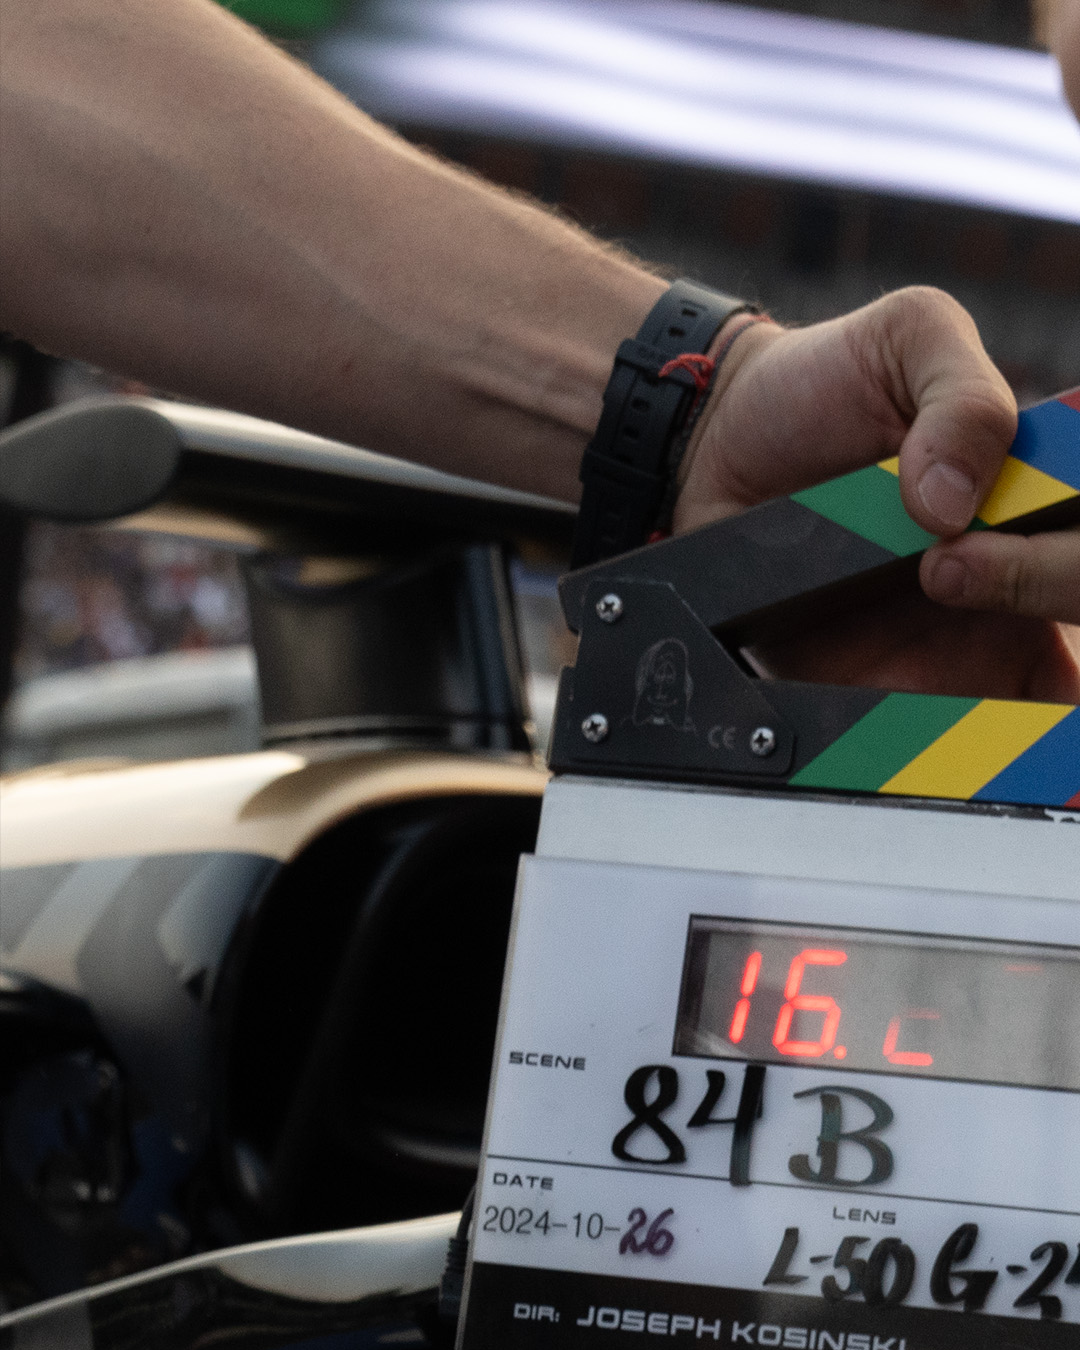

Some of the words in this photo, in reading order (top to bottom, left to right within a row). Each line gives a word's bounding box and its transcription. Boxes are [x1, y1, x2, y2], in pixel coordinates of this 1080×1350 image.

[509, 1051, 587, 1071] SCENE
[611, 1064, 767, 1187] 84
[788, 1085, 896, 1189] B
[493, 1172, 554, 1191] DATE
[832, 1206, 897, 1225] LENS
[513, 1302, 562, 1324] DIR:
[576, 1306, 722, 1341] JOSEPH
